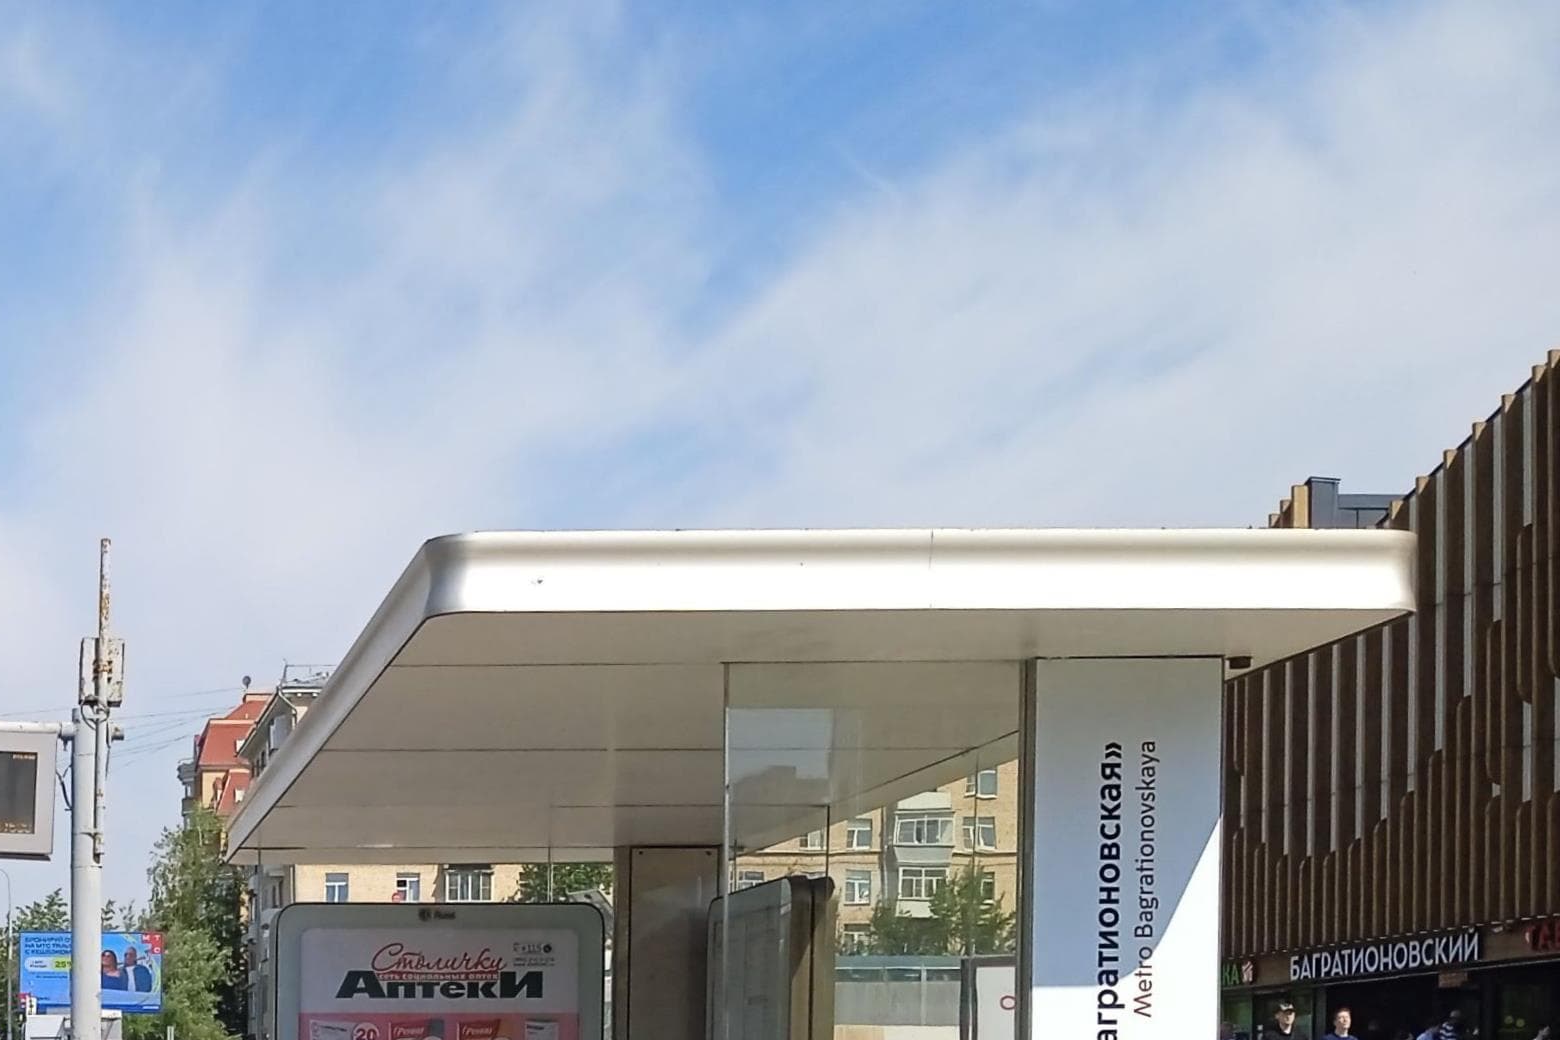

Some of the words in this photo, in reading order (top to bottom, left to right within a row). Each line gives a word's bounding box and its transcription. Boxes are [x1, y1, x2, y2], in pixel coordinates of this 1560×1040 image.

[1134, 740, 1161, 939] Bagrationovskaya
[371, 943, 508, 972] Столички
[1133, 944, 1153, 1018] Metro
[1289, 926, 1479, 982] БАГРАТИОНОВСКИЙ
